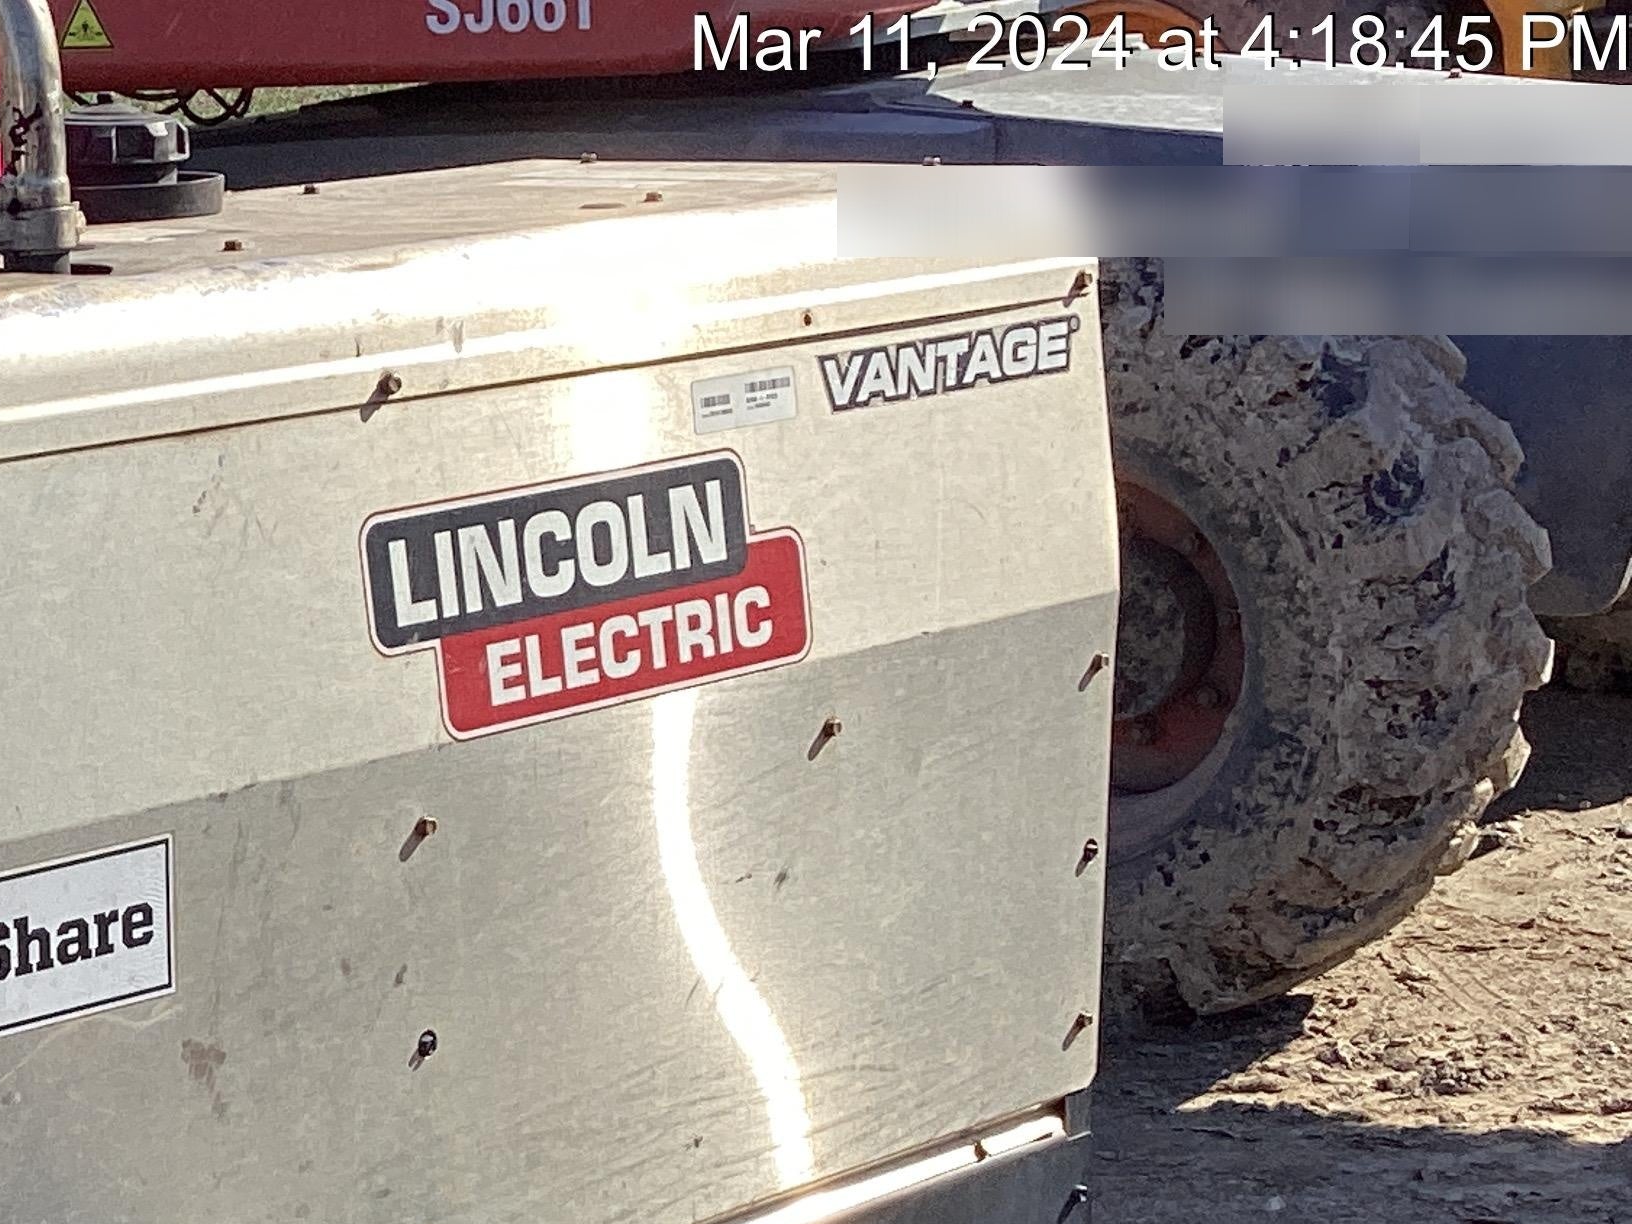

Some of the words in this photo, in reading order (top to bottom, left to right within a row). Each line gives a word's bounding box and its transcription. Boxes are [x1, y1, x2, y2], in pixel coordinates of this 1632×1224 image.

[819, 318, 1071, 411] VANTAGE
[387, 478, 730, 629] LINCOLN
[485, 584, 775, 708] ELECTRIC
